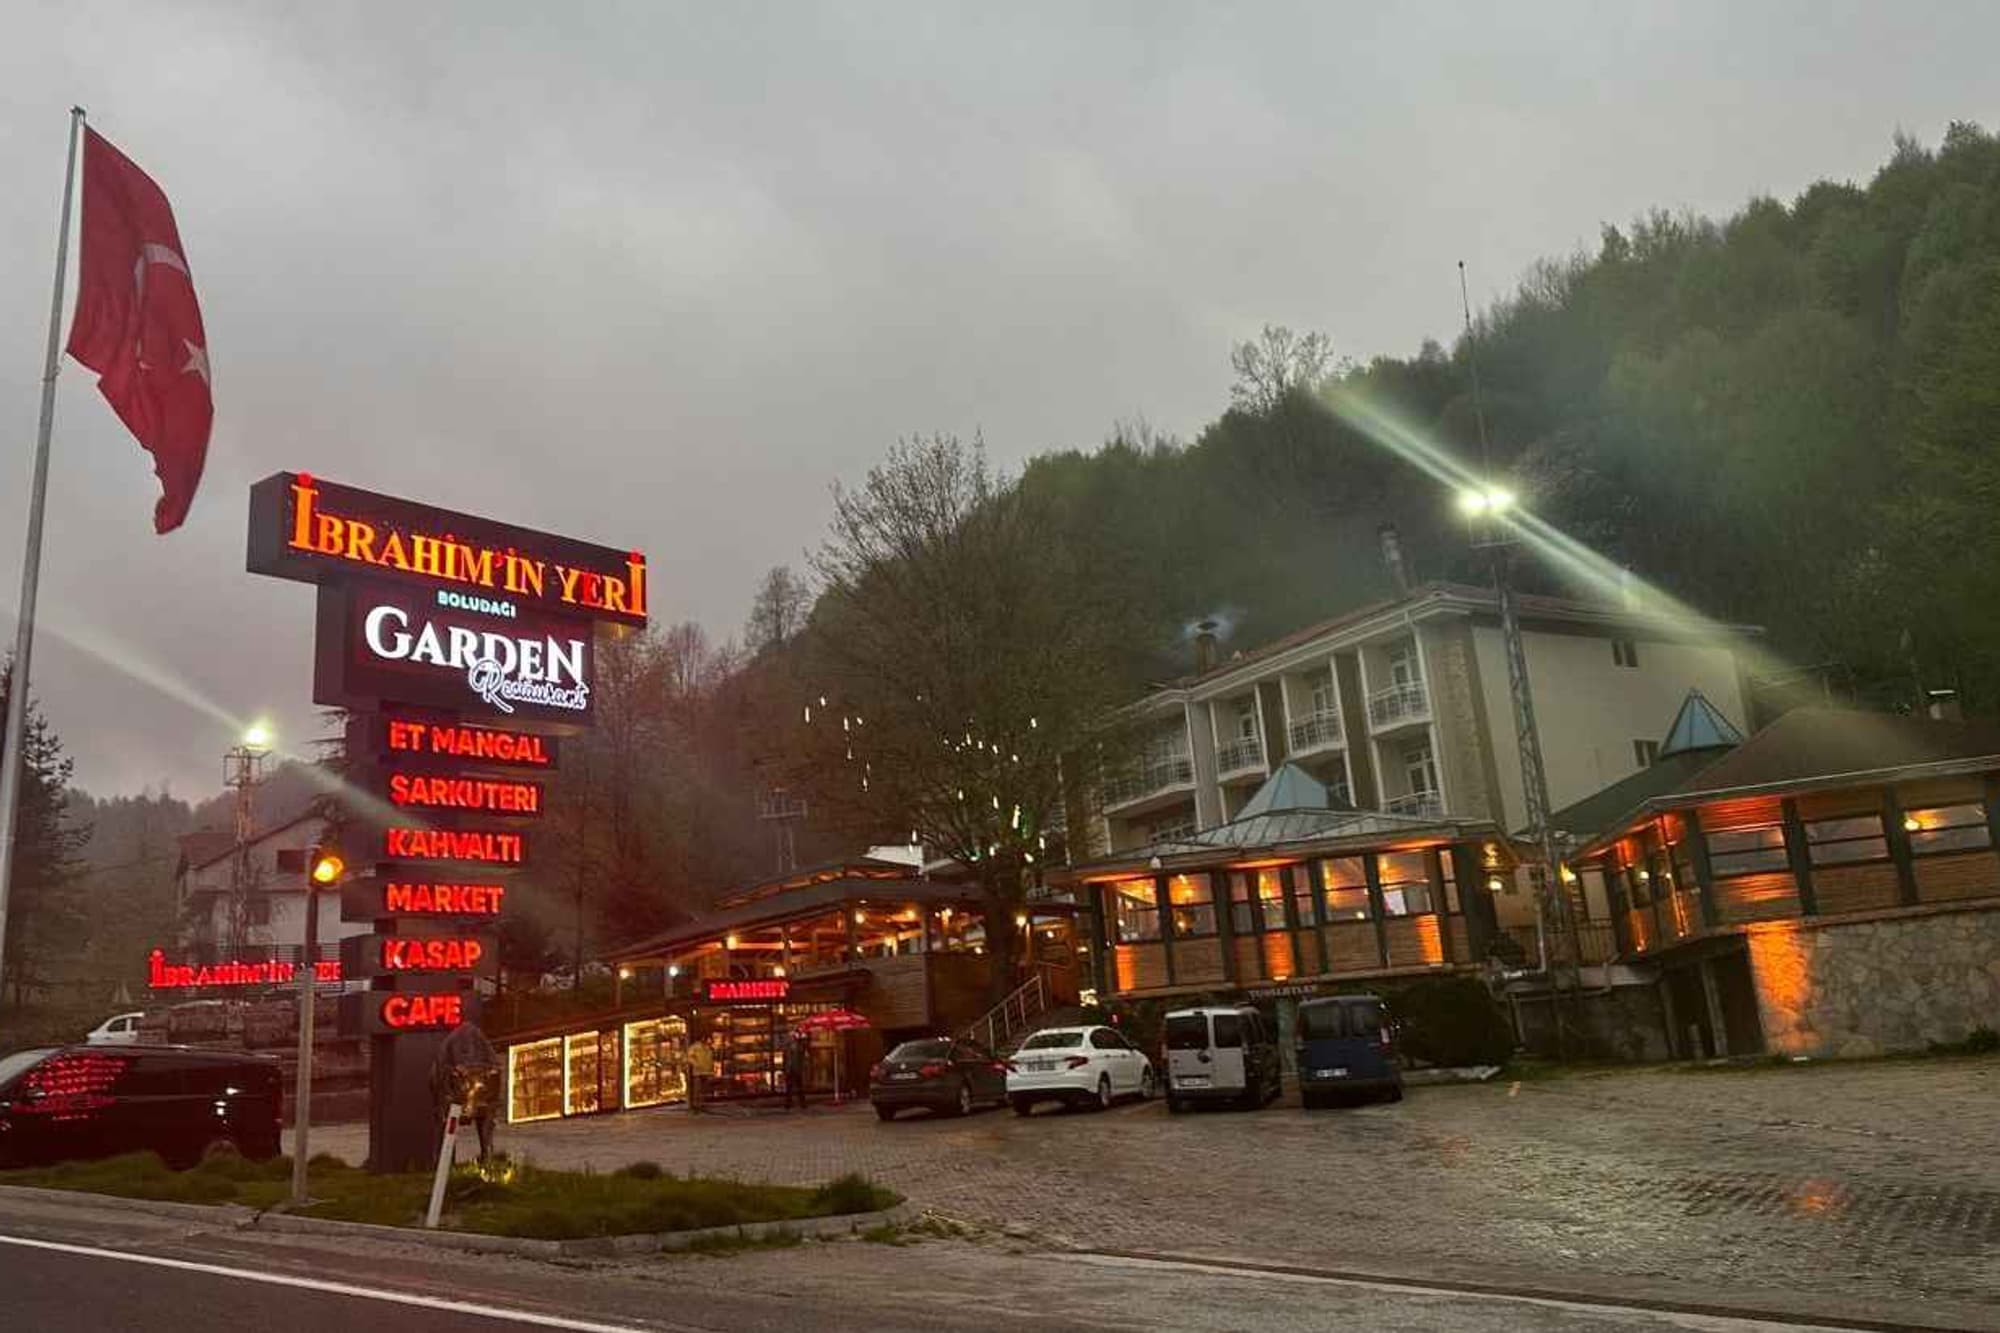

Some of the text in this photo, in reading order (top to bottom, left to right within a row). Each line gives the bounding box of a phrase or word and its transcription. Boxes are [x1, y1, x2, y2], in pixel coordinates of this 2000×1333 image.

[555, 548, 648, 618] YERİ
[364, 606, 586, 685] GARDEN
[389, 721, 548, 763] ET MANGAL
[387, 828, 521, 862] KAHVALTI
[386, 883, 504, 913] MARKET
[383, 940, 481, 969] KASAP
[383, 996, 461, 1027] CAFE
